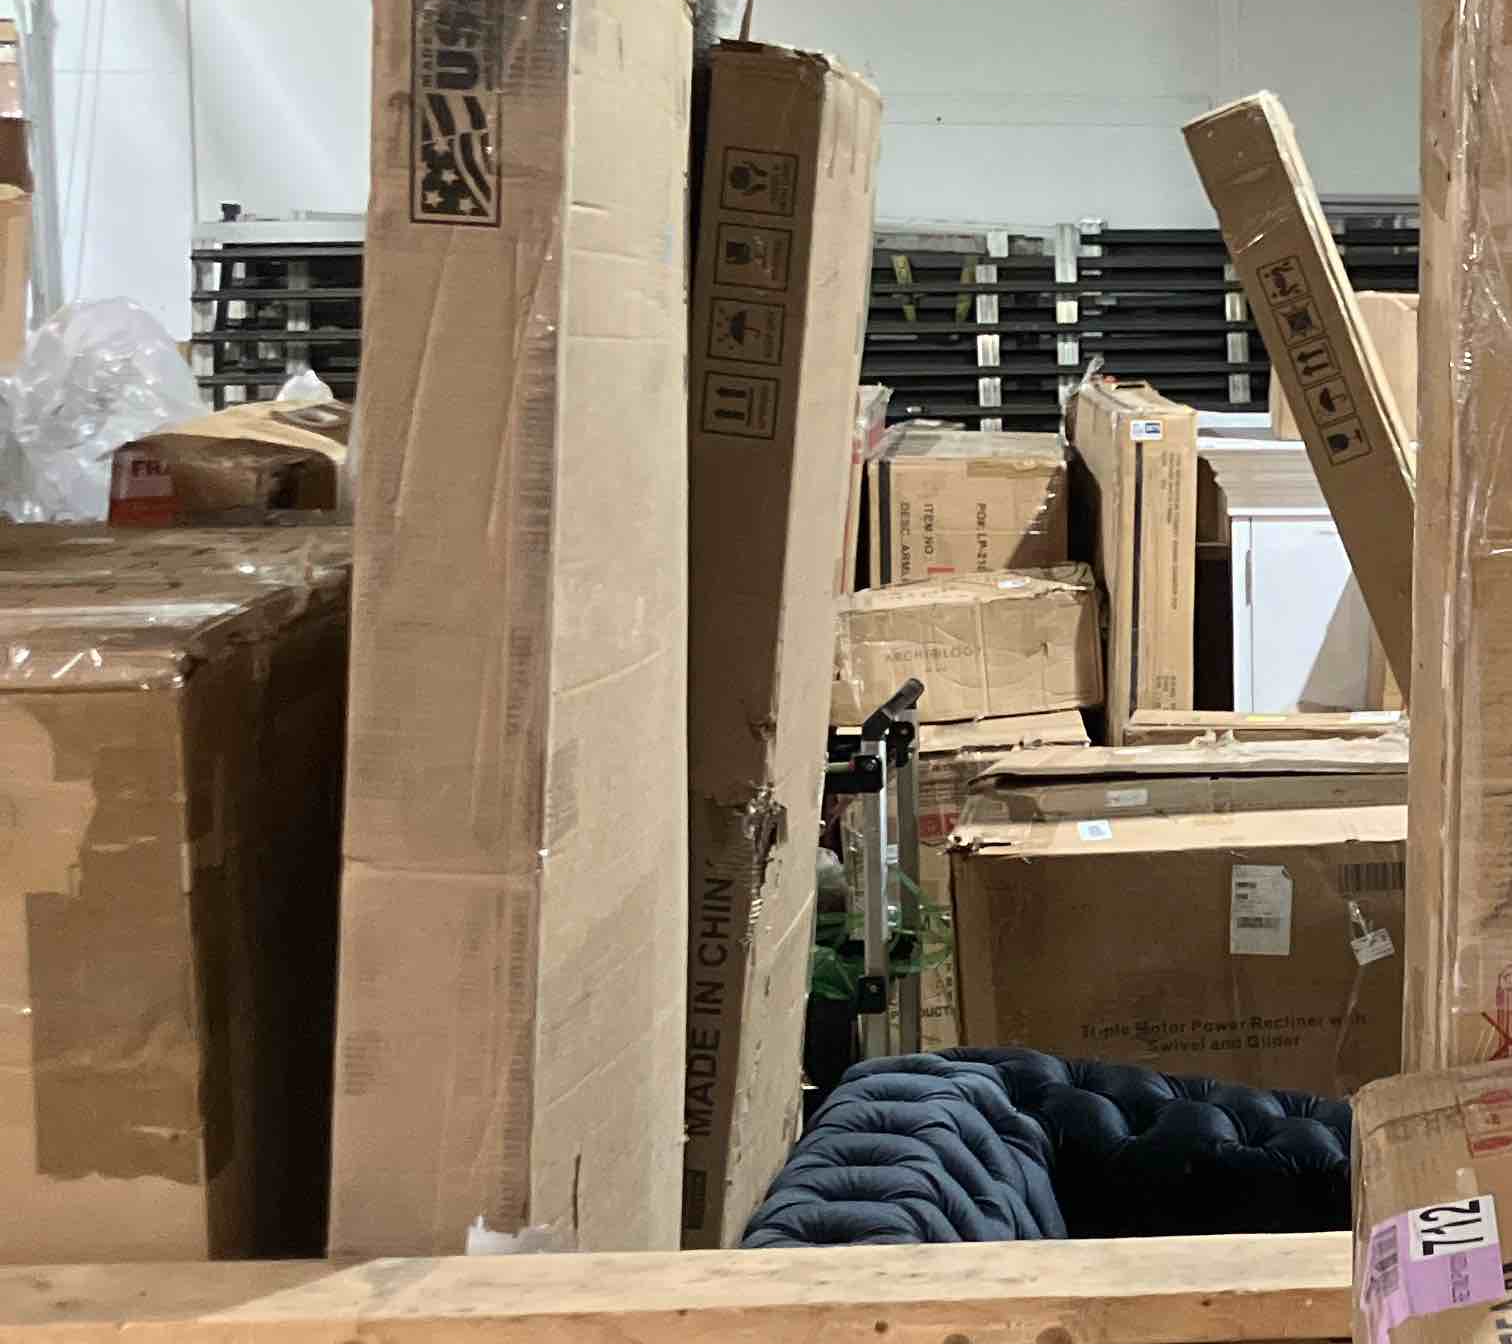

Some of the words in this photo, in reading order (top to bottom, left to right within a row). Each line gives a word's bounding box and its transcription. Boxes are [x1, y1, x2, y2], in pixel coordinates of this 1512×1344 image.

[698, 873, 735, 965] CHIN
[695, 981, 723, 1015] IN
[1191, 1017, 1247, 1033] Power
[1251, 1015, 1324, 1031] Recliner
[1330, 1013, 1367, 1027] wth
[1210, 1035, 1242, 1051] and
[1248, 1034, 1299, 1050] Glider
[687, 1029, 719, 1138] MADE
[1419, 1199, 1485, 1257] 712
